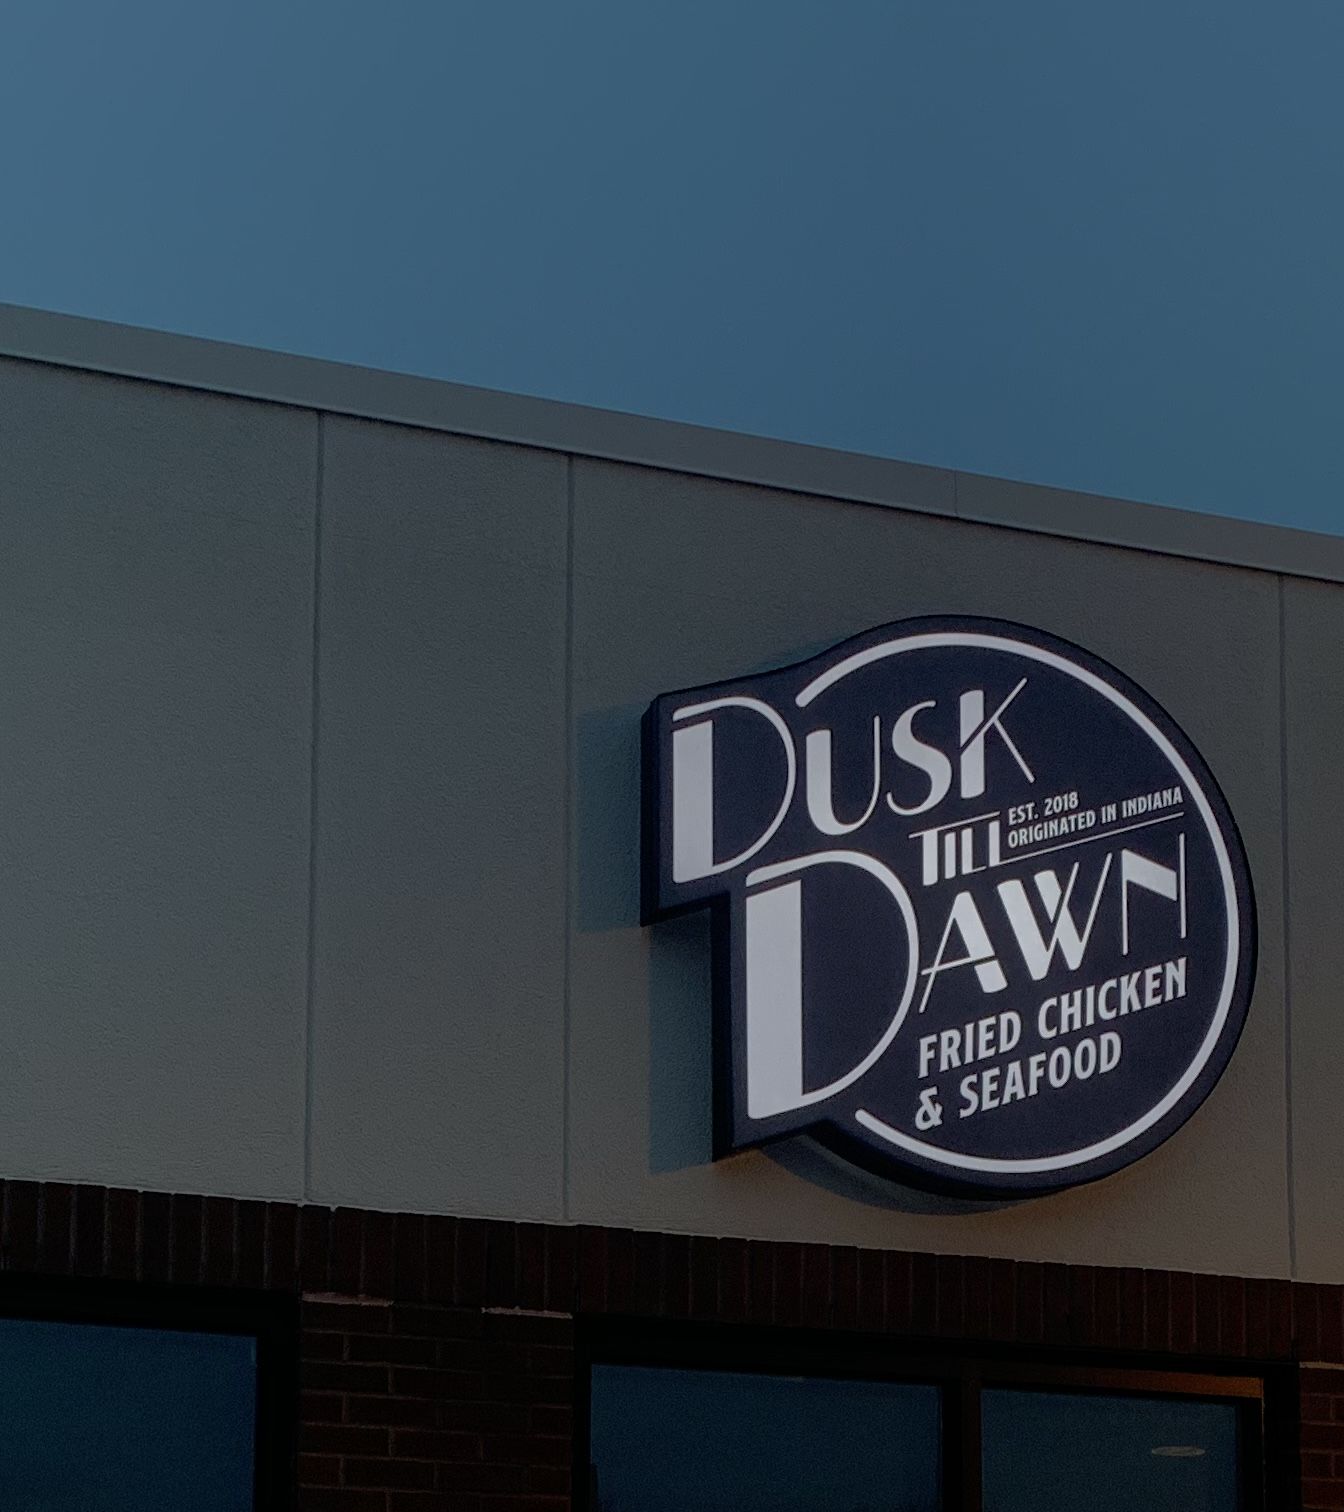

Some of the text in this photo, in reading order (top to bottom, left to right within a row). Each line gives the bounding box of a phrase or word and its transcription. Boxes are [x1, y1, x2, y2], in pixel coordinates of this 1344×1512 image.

[908, 811, 1001, 886] TILL
[1007, 791, 1079, 826] EST. 2018
[1007, 786, 1184, 849] ORIGINATED IN INDIANA
[745, 832, 1188, 1121] DAWN
[917, 956, 1188, 1080] FRIED CHICKEN
[914, 1031, 1123, 1131] & SEAFOOD
